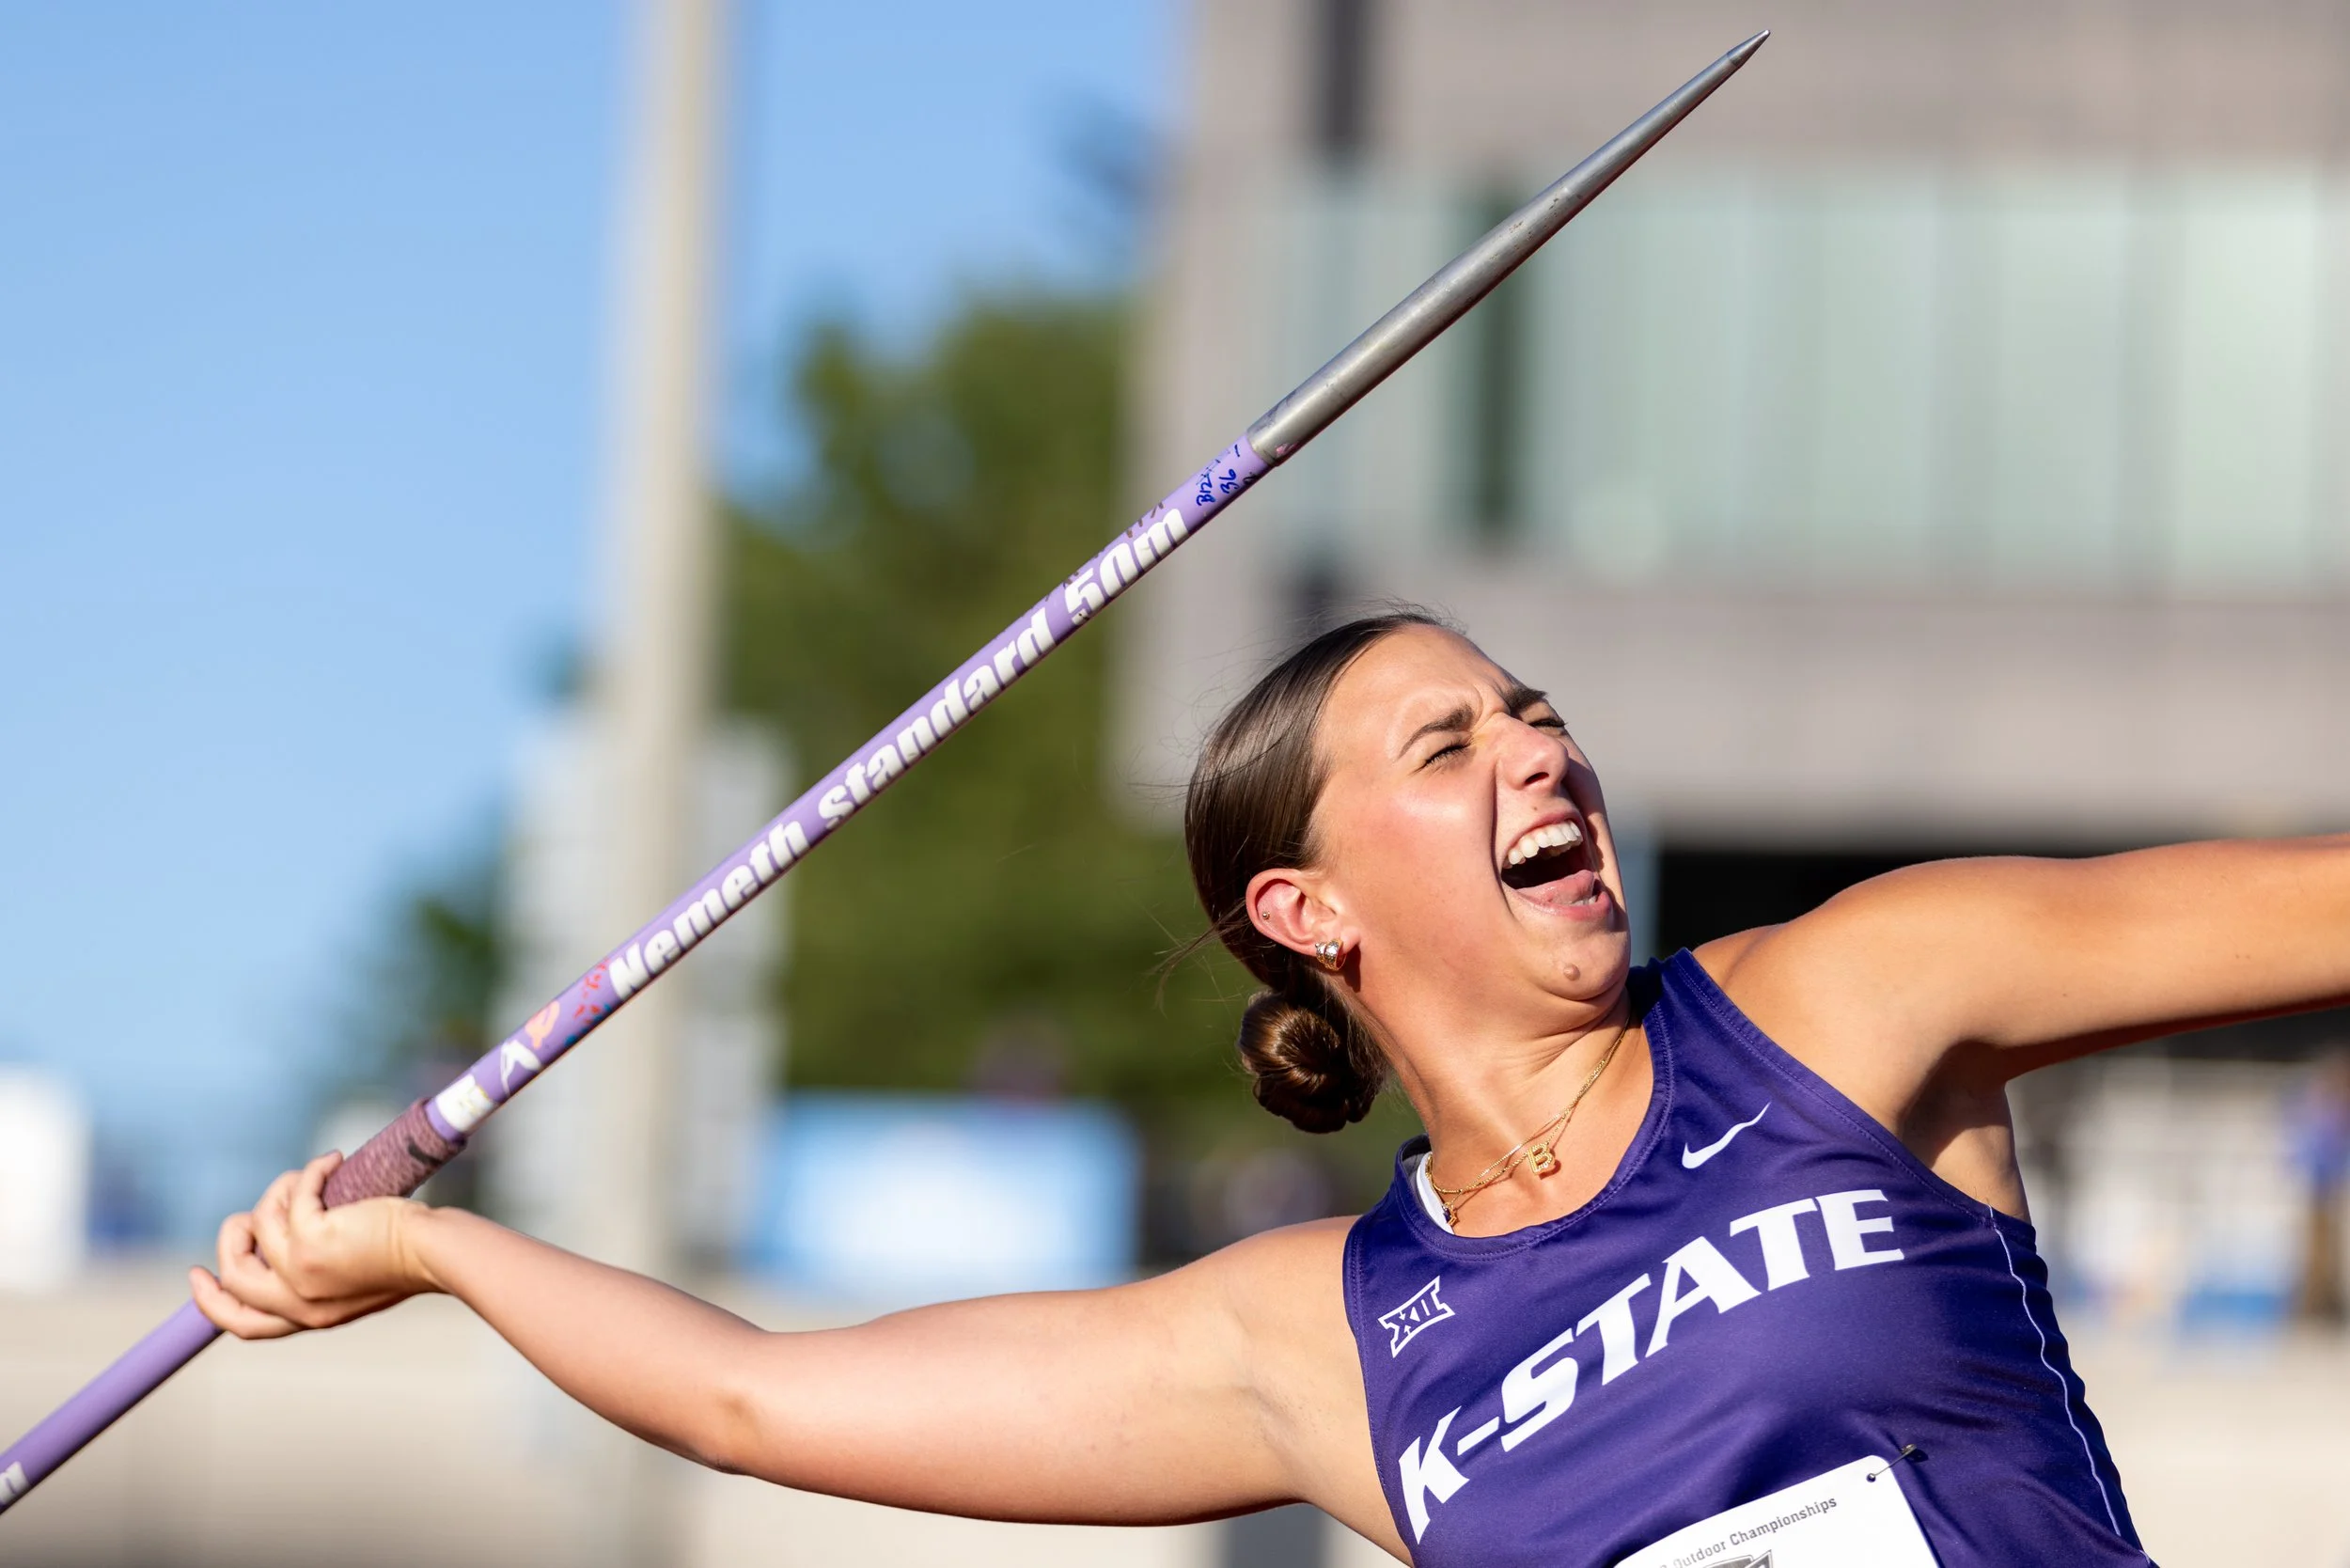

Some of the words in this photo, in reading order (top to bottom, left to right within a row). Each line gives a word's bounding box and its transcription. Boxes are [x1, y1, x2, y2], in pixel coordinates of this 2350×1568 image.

[609, 821, 809, 1000] Nemeth
[818, 607, 1056, 829] standard
[1065, 509, 1188, 625] 50m
[1528, 1141, 1555, 1175] B
[1398, 1189, 1904, 1544] K-STATE
[1673, 1541, 1727, 1568] Outdoor
[1730, 1497, 1838, 1546] Championships
